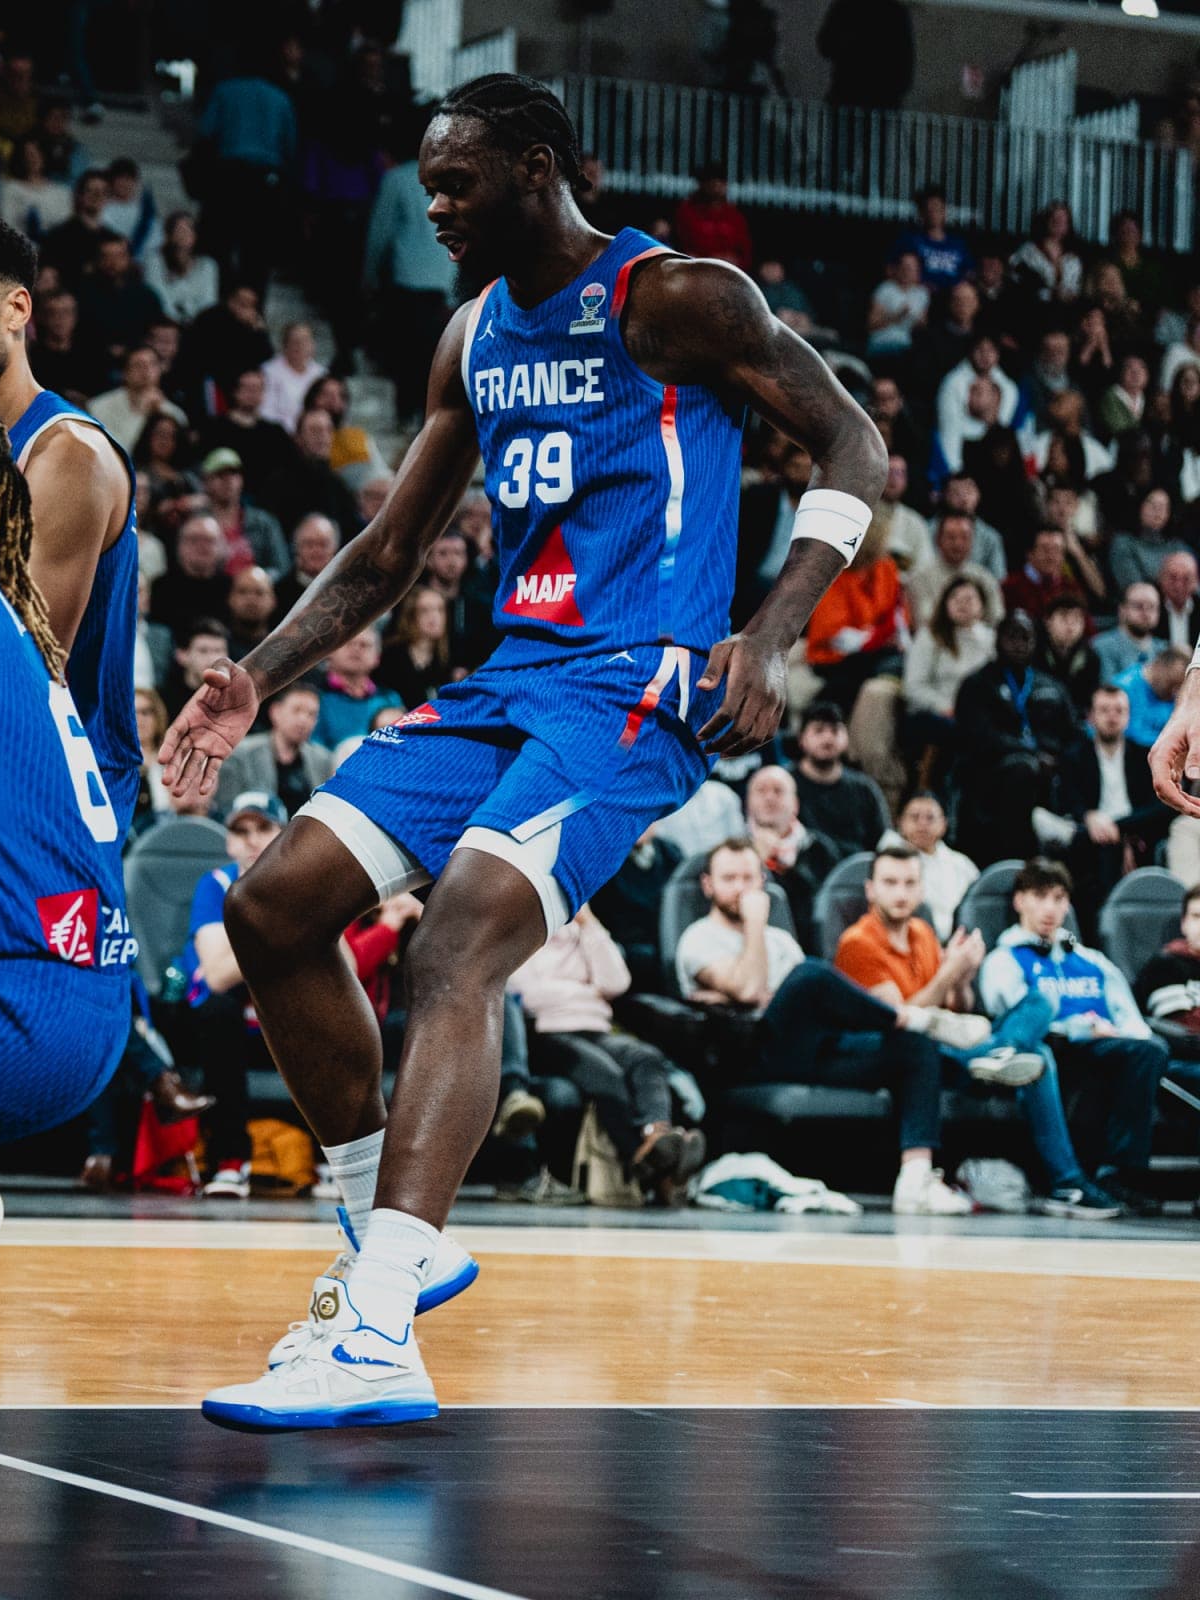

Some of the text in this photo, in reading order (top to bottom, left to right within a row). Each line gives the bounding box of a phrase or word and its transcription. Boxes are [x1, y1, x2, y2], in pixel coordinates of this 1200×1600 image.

[475, 358, 604, 414] FRANCE
[499, 431, 574, 509] 39
[515, 573, 578, 605] MAIF
[48, 679, 119, 843] 6
